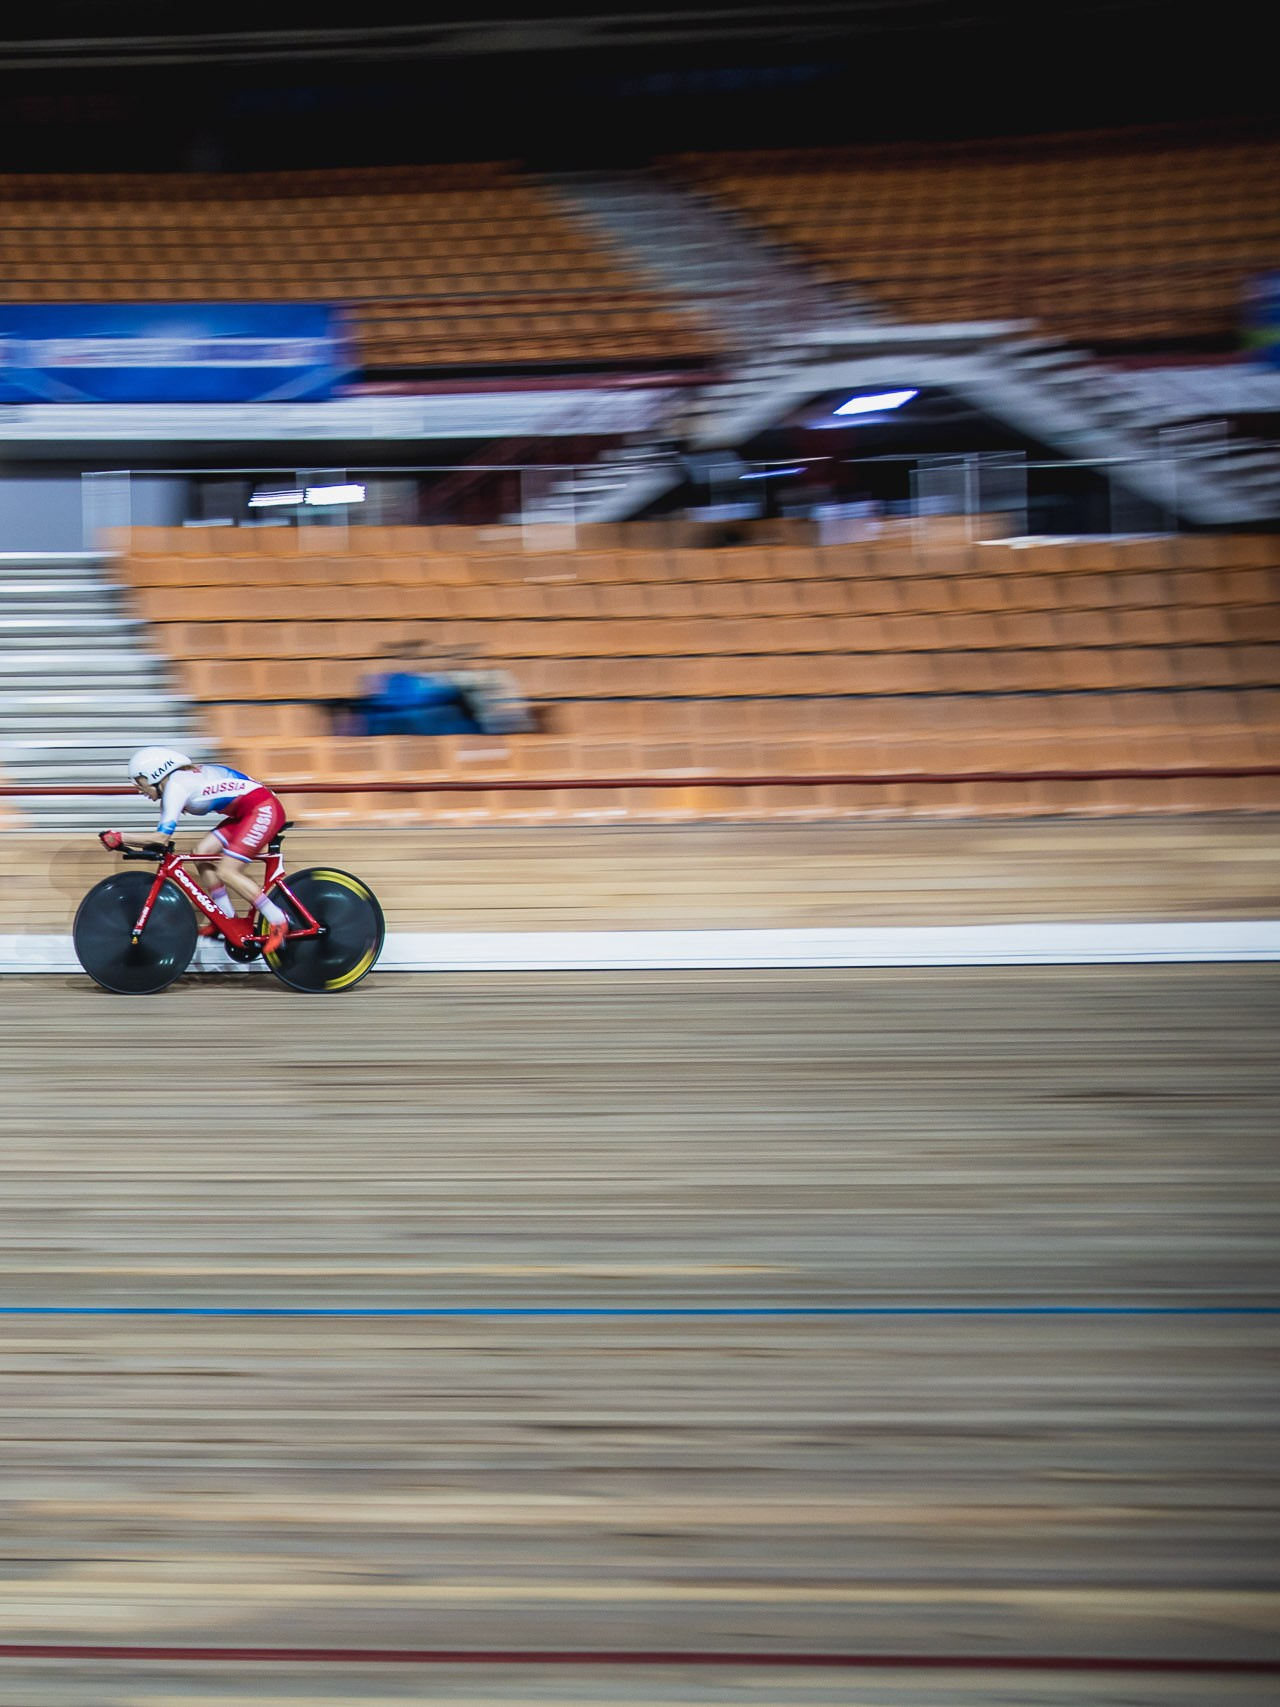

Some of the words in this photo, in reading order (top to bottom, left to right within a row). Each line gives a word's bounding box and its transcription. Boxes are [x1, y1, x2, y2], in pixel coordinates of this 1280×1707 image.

[150, 758, 175, 780] KASK
[202, 782, 247, 796] RUSSIA
[241, 805, 273, 848] RUSSIA
